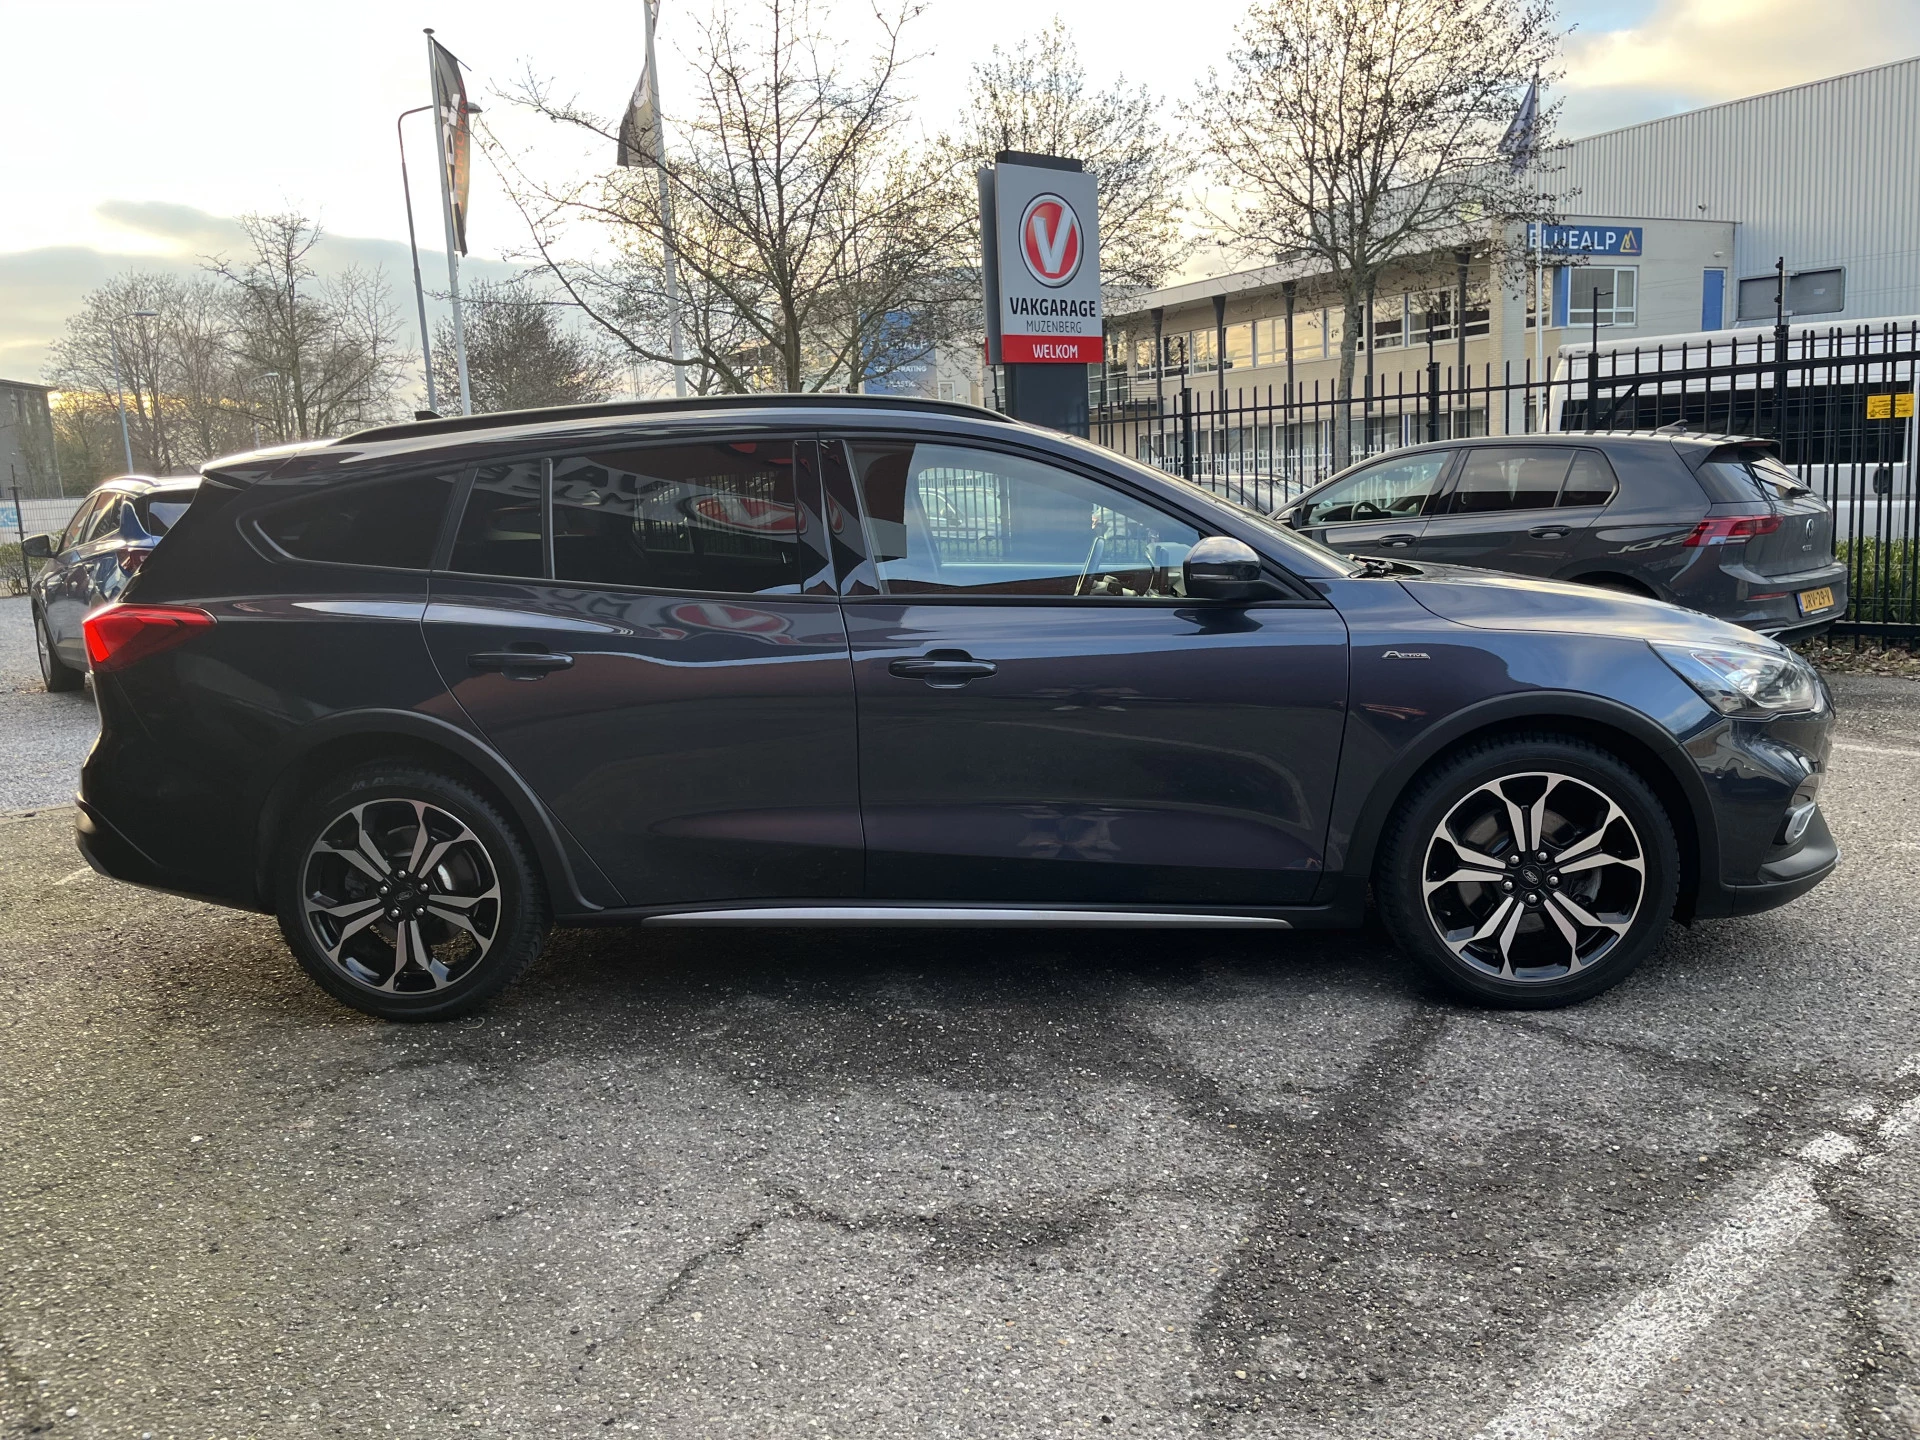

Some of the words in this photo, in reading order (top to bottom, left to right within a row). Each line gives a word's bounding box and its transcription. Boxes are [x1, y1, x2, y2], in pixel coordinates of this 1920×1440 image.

[1009, 297, 1096, 317] VAKGARAGE
[1026, 320, 1082, 334] MUZENBERG
[1032, 344, 1078, 359] WELKOM
